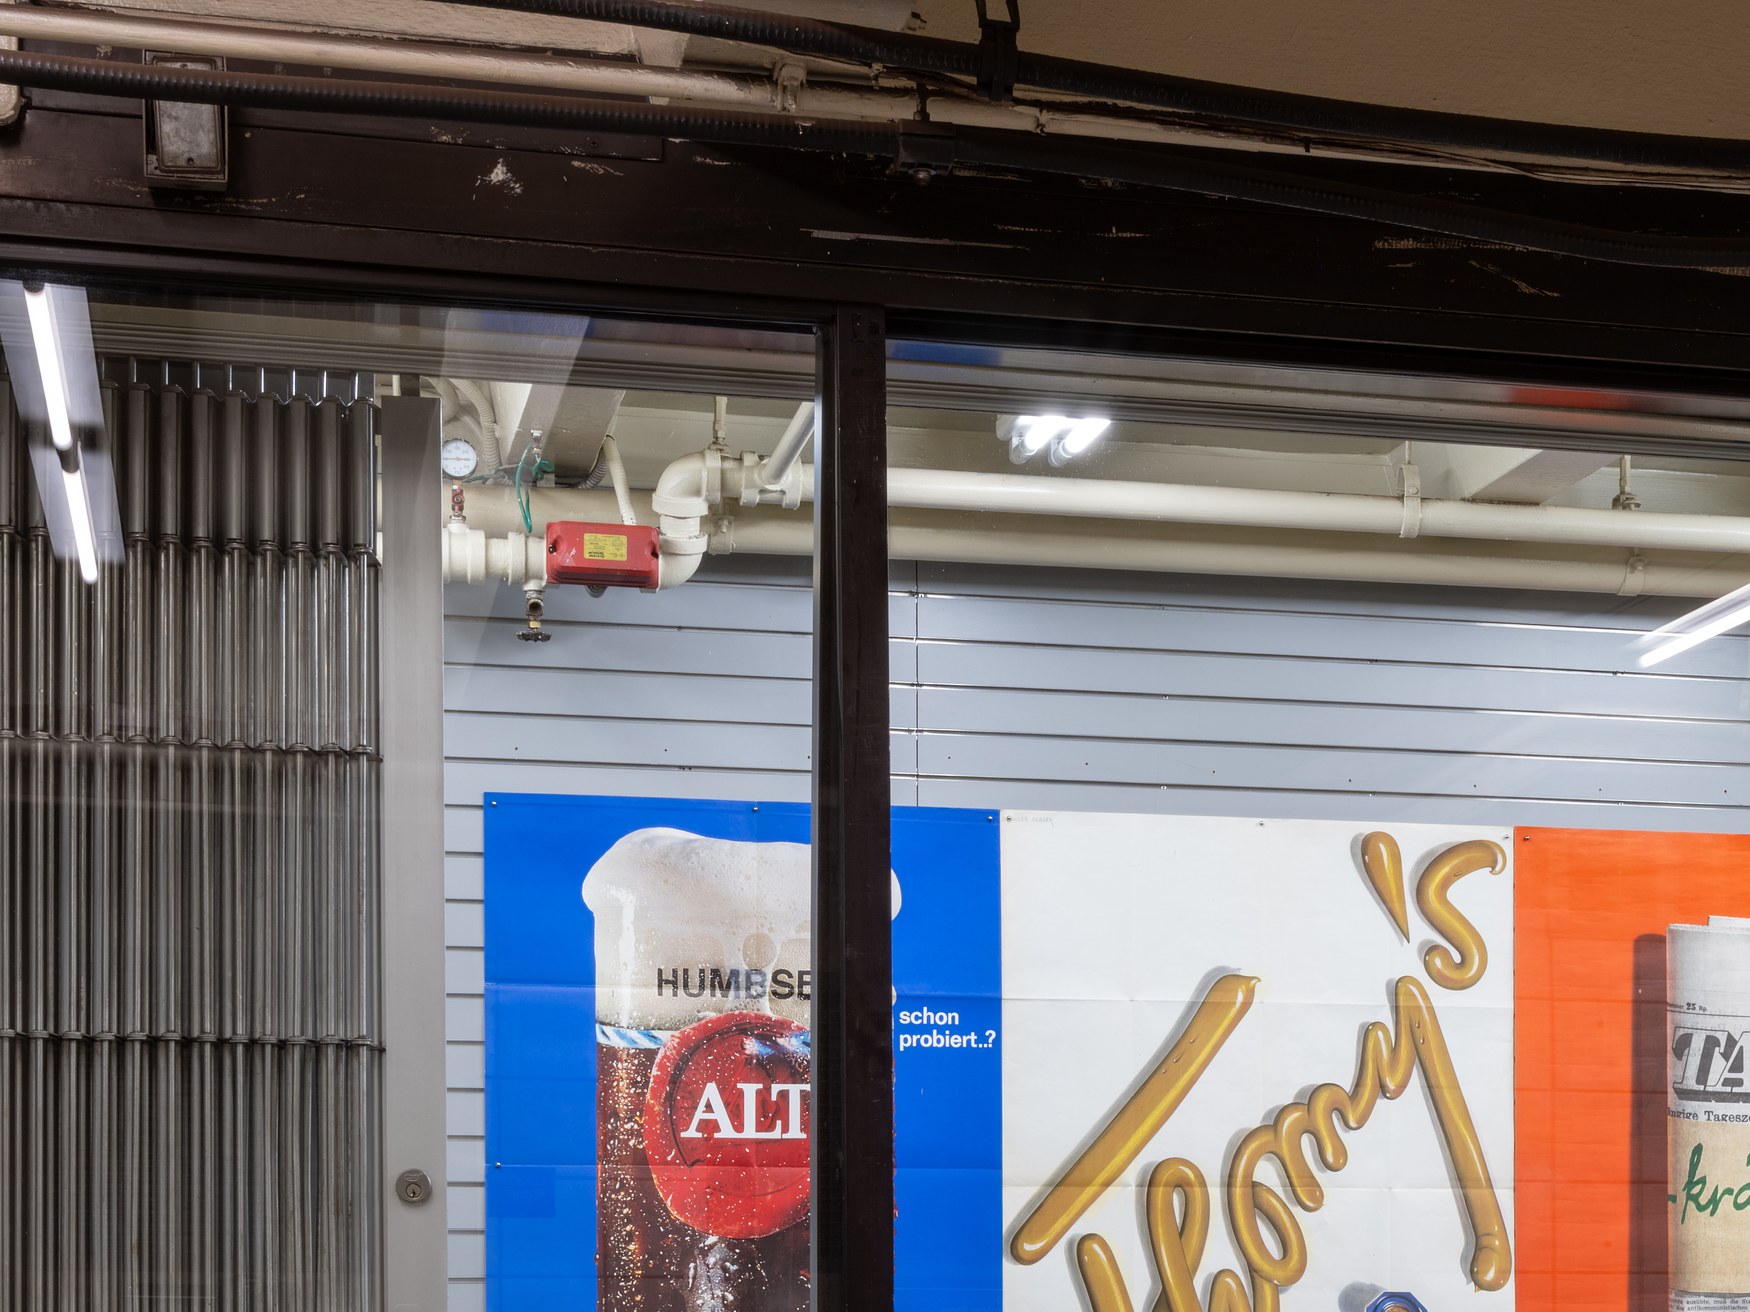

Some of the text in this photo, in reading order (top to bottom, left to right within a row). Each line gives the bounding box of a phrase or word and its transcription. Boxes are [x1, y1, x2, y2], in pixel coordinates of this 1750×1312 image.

[657, 968, 811, 1000] HUMBSE
[899, 1007, 959, 1025] schon
[1686, 1002, 1696, 1010] 25
[900, 1029, 996, 1051] probiert..?
[680, 1082, 811, 1139] ALT
